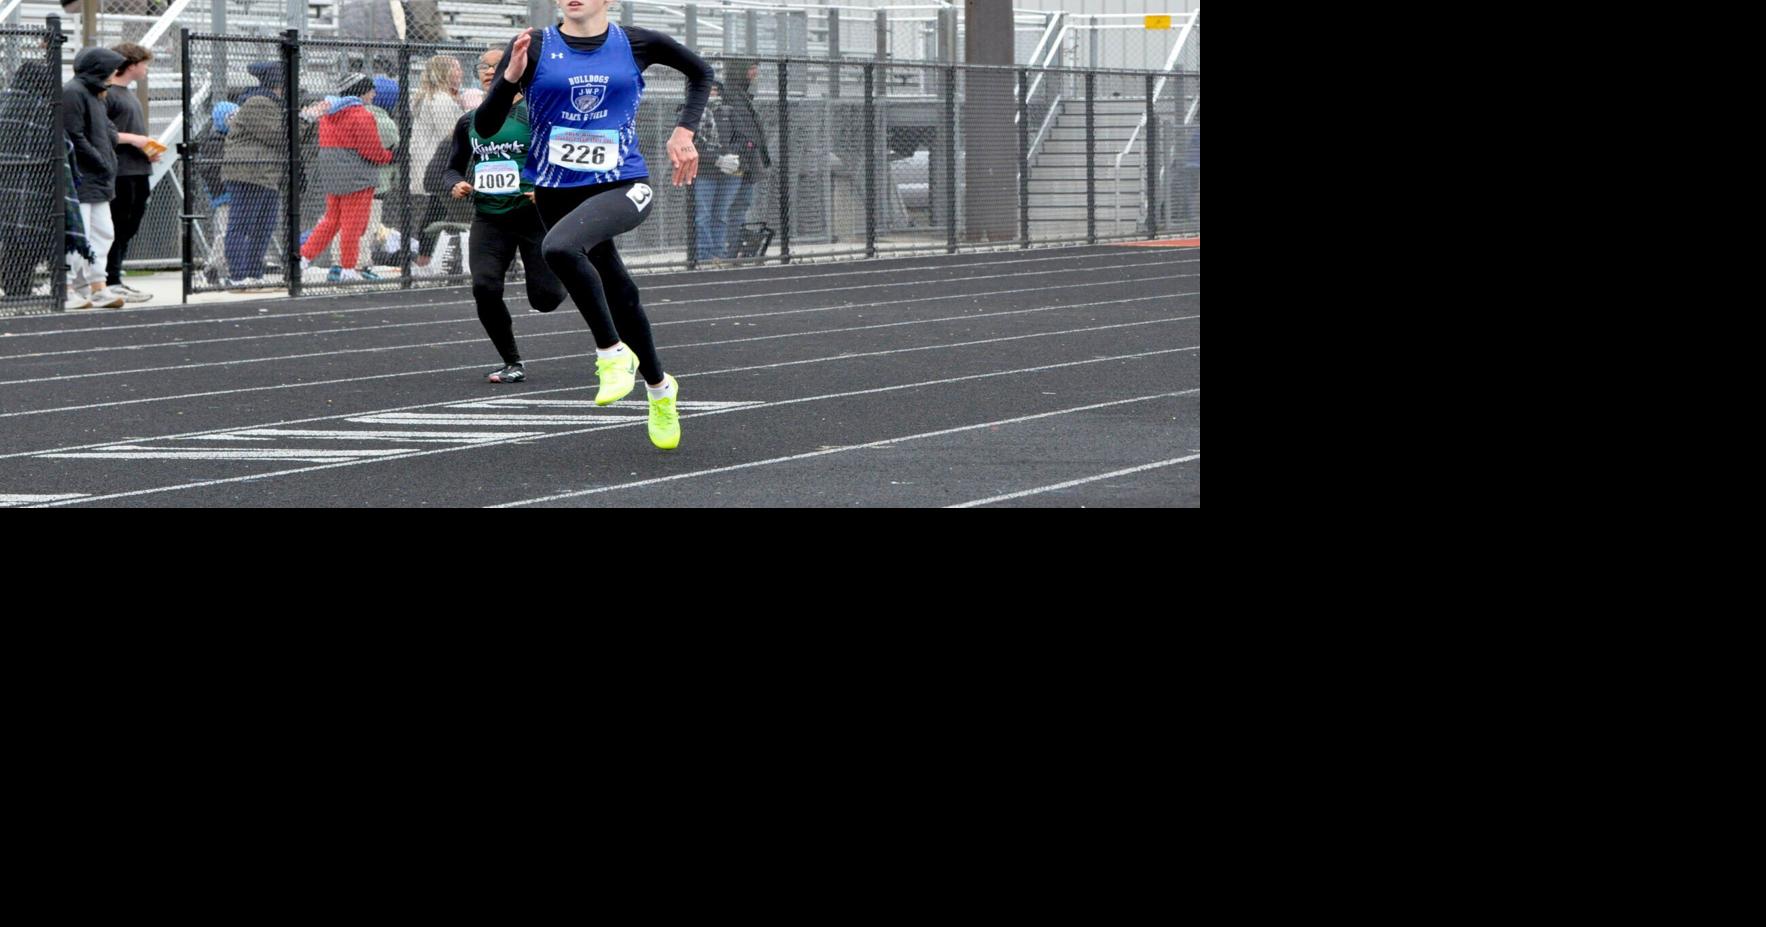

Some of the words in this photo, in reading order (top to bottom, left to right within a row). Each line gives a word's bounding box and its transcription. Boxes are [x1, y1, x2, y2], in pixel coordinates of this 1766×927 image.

[568, 74, 610, 86] BULLDOGS
[561, 111, 581, 121] TRACK
[589, 109, 609, 120] FIELD
[560, 143, 606, 165] 226
[478, 173, 516, 189] 1002
[632, 185, 650, 204] 3
